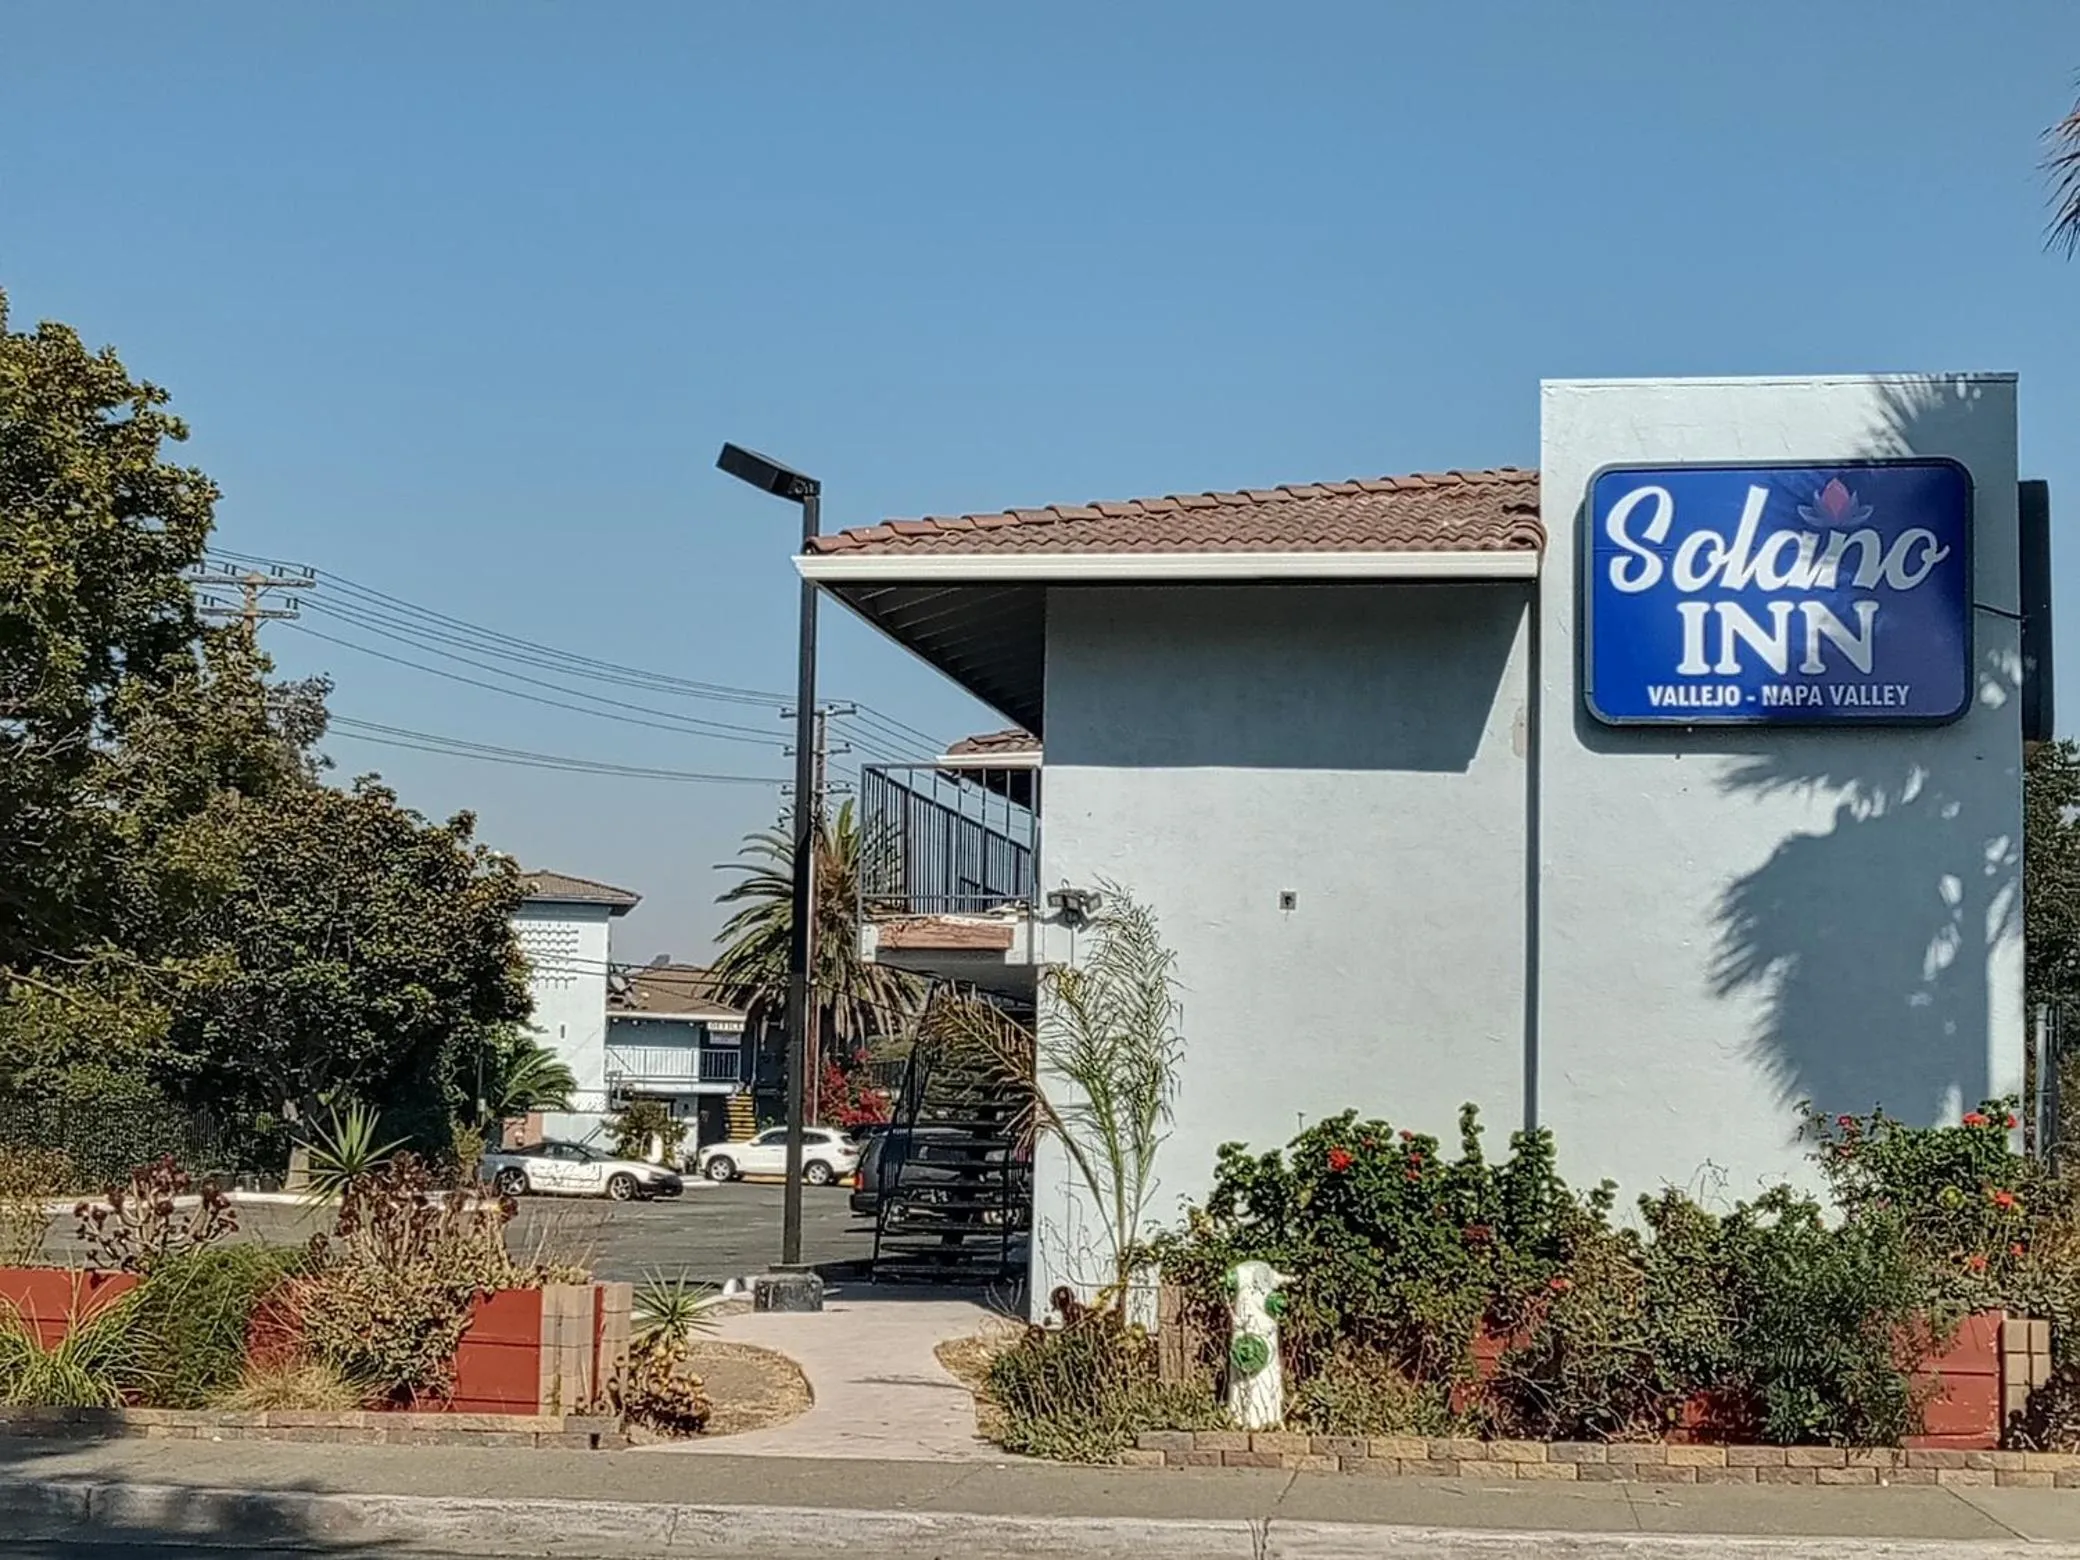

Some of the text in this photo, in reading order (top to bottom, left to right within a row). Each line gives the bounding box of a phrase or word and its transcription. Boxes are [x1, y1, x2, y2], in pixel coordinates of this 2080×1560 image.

[1605, 485, 1950, 592] Solano
[1676, 601, 1879, 675] INN
[1647, 685, 1741, 706] VALLEJO
[1762, 685, 1823, 706] NAPA
[1829, 685, 1910, 706] VALLEY
